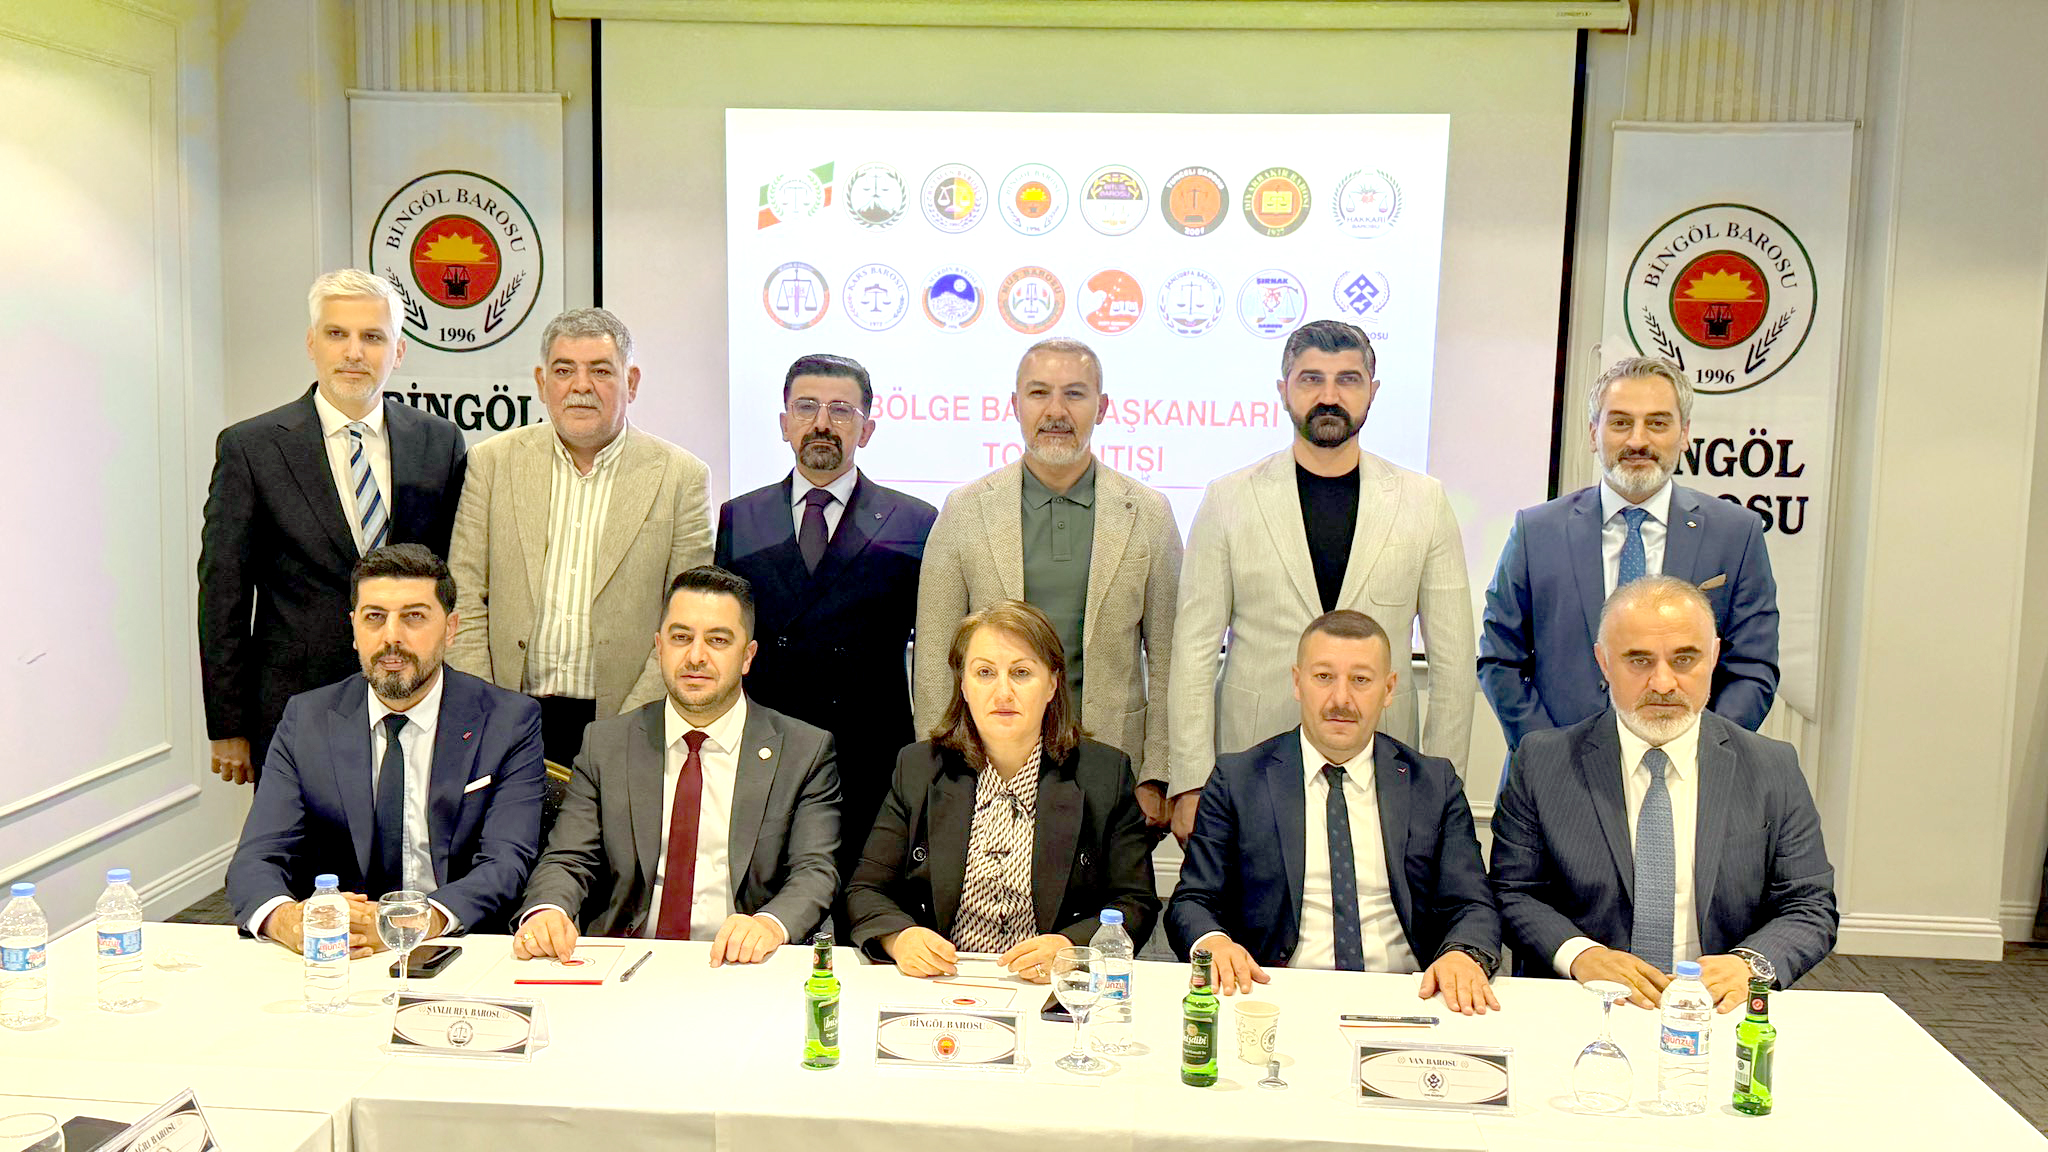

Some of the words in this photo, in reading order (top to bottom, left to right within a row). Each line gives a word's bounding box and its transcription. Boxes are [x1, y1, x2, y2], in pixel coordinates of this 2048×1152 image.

[386, 188, 451, 250] BİNGÖL
[456, 188, 526, 252] BAROSU
[1644, 223, 1719, 288] BİNGÖL
[1726, 222, 1797, 289] BAROSU
[848, 269, 868, 291] KARS
[871, 267, 905, 292] BAROSU
[439, 327, 476, 343] 1996
[1696, 369, 1735, 385] 1996
[870, 386, 970, 421] BÖLGE
[1102, 398, 1279, 433] AŞKANLARI
[1673, 428, 1805, 478] NGÖL
[426, 1004, 468, 1015] ŞANLIURFA
[470, 1008, 502, 1018] BAROSU
[909, 1017, 946, 1029] BİNGÖL
[947, 1020, 986, 1030] BAROSU
[1408, 1057, 1425, 1065] VAN
[1426, 1058, 1459, 1067] BAROSU
[150, 1122, 177, 1145] BAROSU
